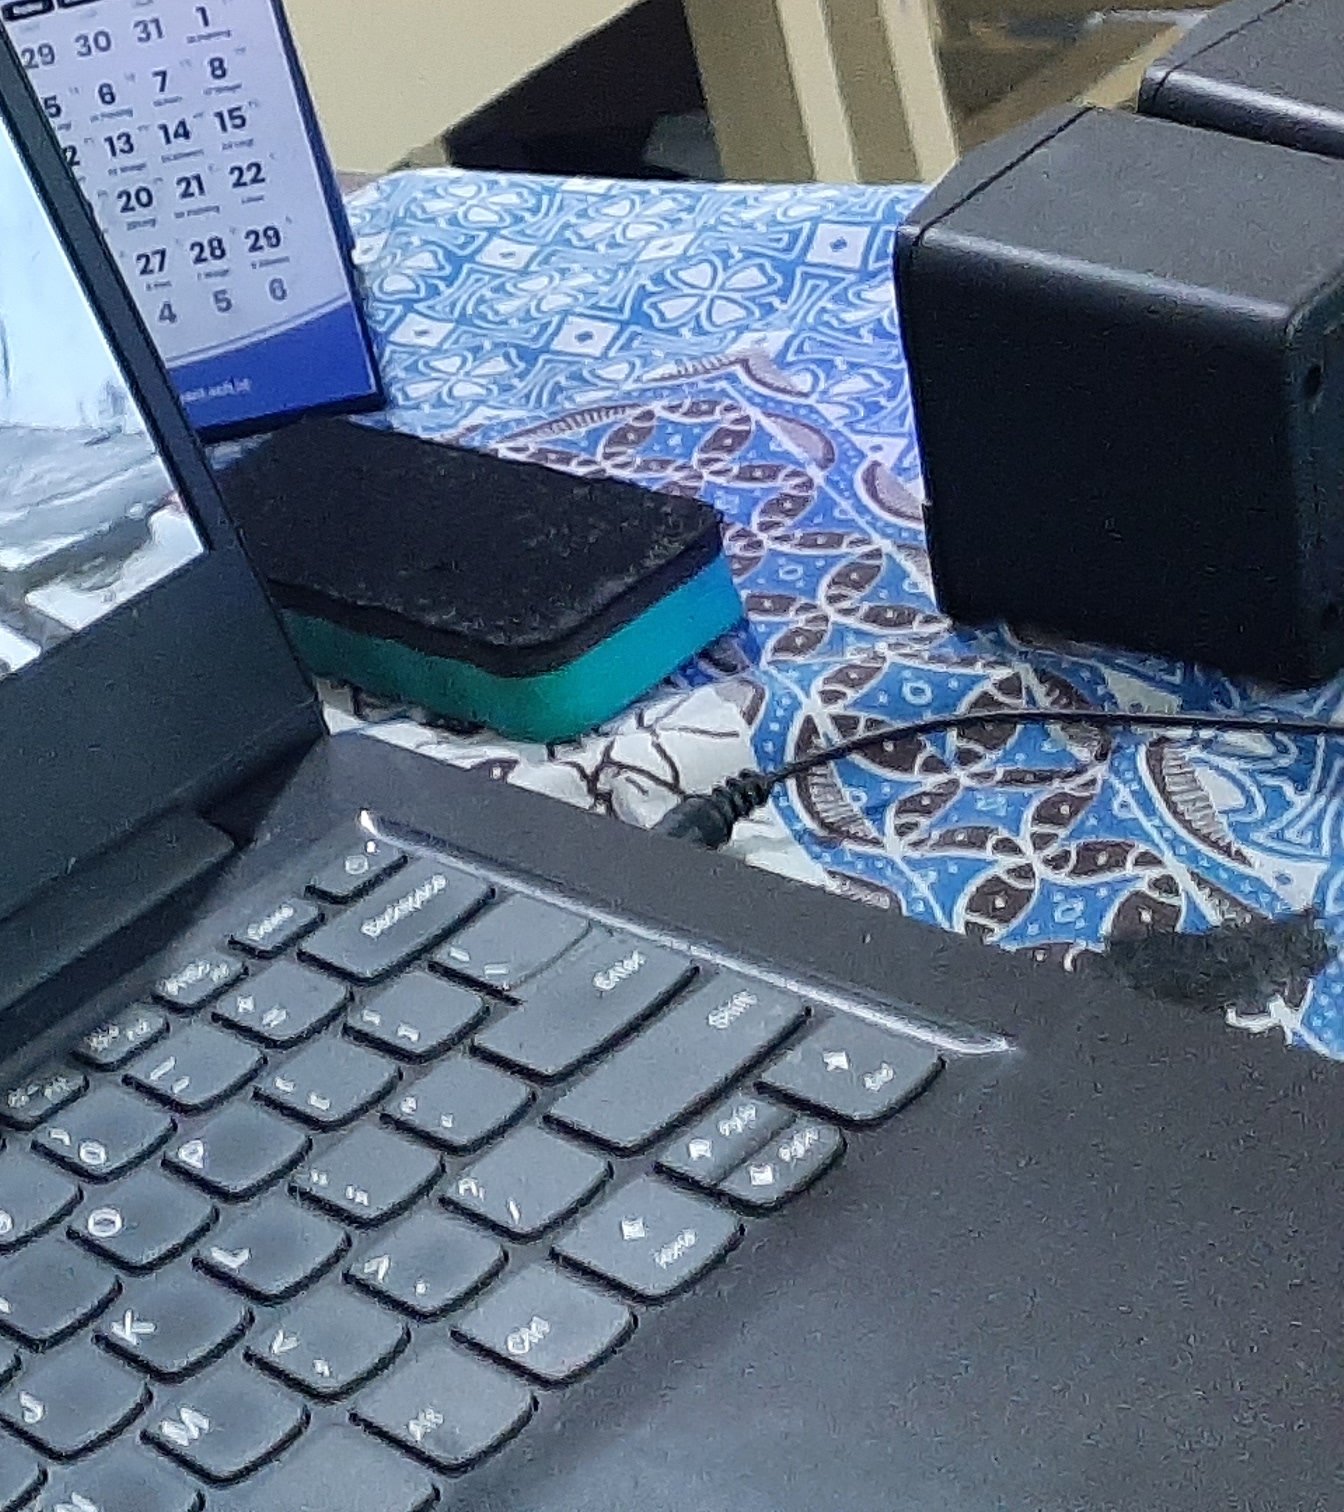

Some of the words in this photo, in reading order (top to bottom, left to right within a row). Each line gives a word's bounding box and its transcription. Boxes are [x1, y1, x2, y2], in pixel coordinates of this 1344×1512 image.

[20, 43, 56, 69] 29
[74, 31, 112, 57] 30
[133, 18, 164, 43] 31
[194, 5, 210, 27] 1
[44, 95, 61, 119] 5
[98, 82, 117, 106] 6
[151, 69, 169, 93] 7
[209, 56, 228, 80] 8
[62, 144, 81, 168] 2
[103, 131, 135, 157] 13
[158, 118, 192, 145] 14
[214, 105, 247, 133] 15
[116, 186, 154, 213] 20
[176, 173, 206, 199] 21
[228, 162, 266, 188] 22
[135, 248, 167, 275] 27
[189, 236, 226, 265] 28
[244, 226, 282, 252] 29
[158, 300, 177, 324] 4
[214, 289, 233, 313] 5
[177, 1139, 205, 1168] P
[211, 1246, 252, 1269] L
[111, 1309, 157, 1346] K
[18, 1390, 45, 1424] J
[160, 1406, 211, 1447] M
